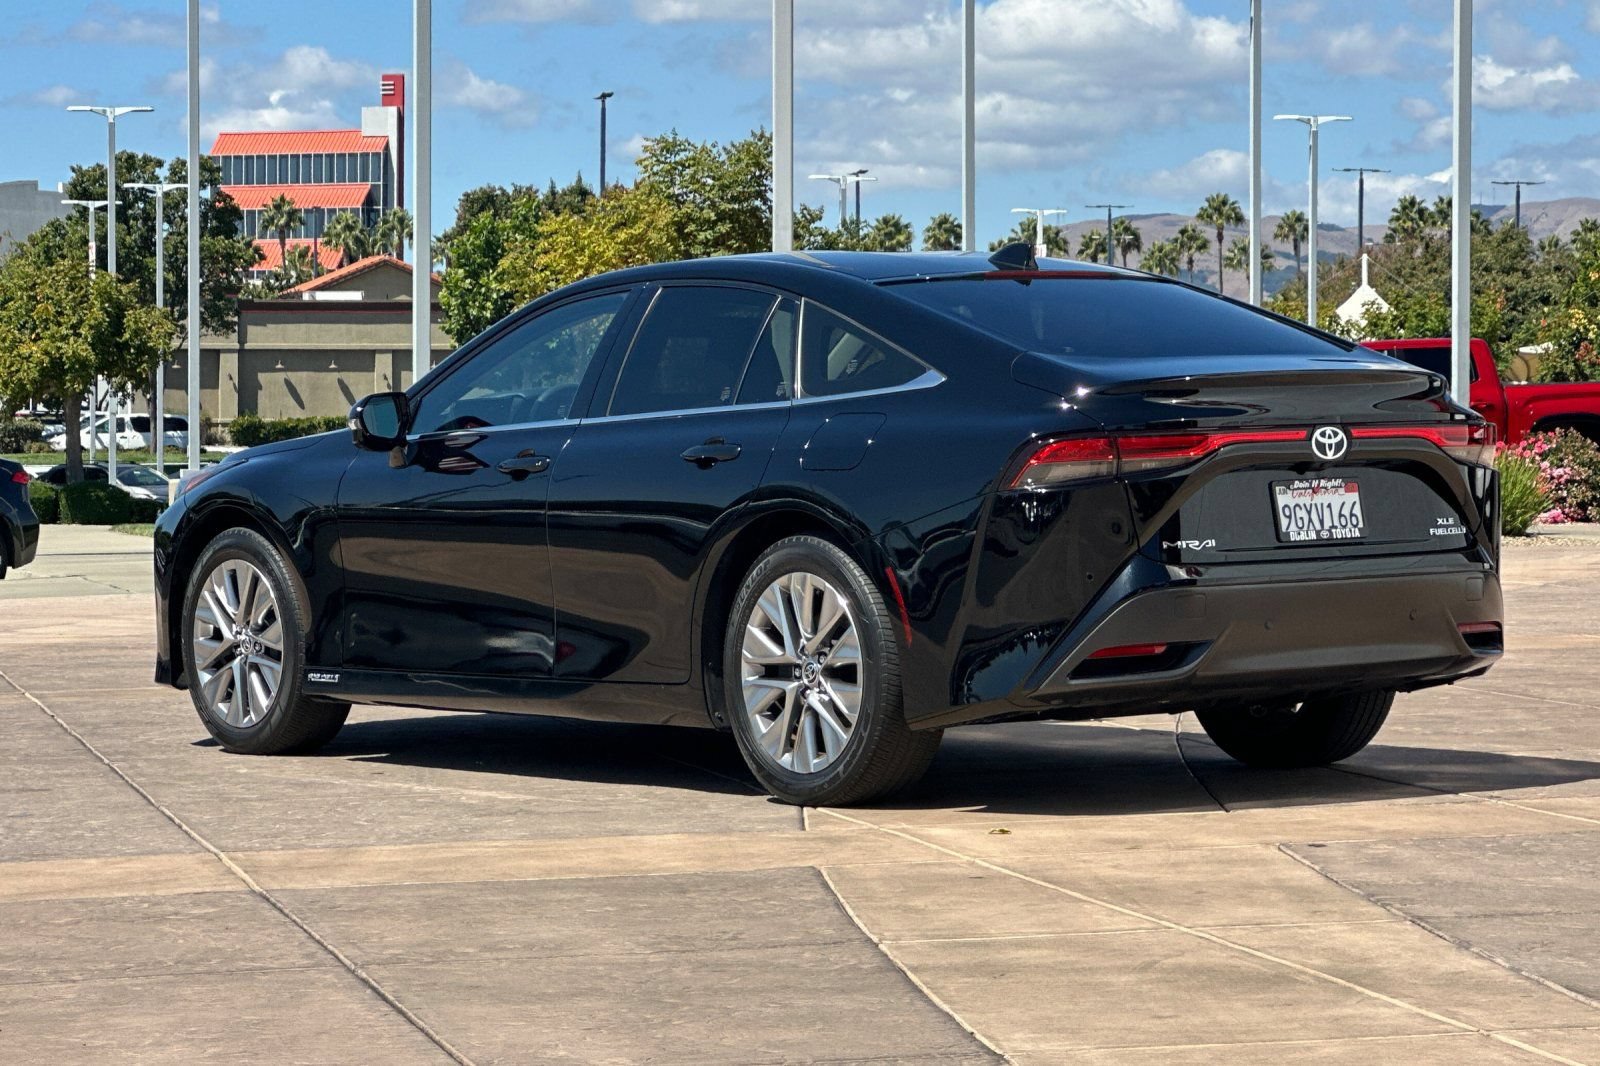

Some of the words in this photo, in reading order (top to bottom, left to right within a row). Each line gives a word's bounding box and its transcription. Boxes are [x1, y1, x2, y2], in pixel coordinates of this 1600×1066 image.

[1281, 500, 1360, 531] 9GXV166
[1436, 517, 1455, 526] XLE
[1331, 528, 1361, 539] TOYOTA
[1162, 539, 1216, 550] MIRAI
